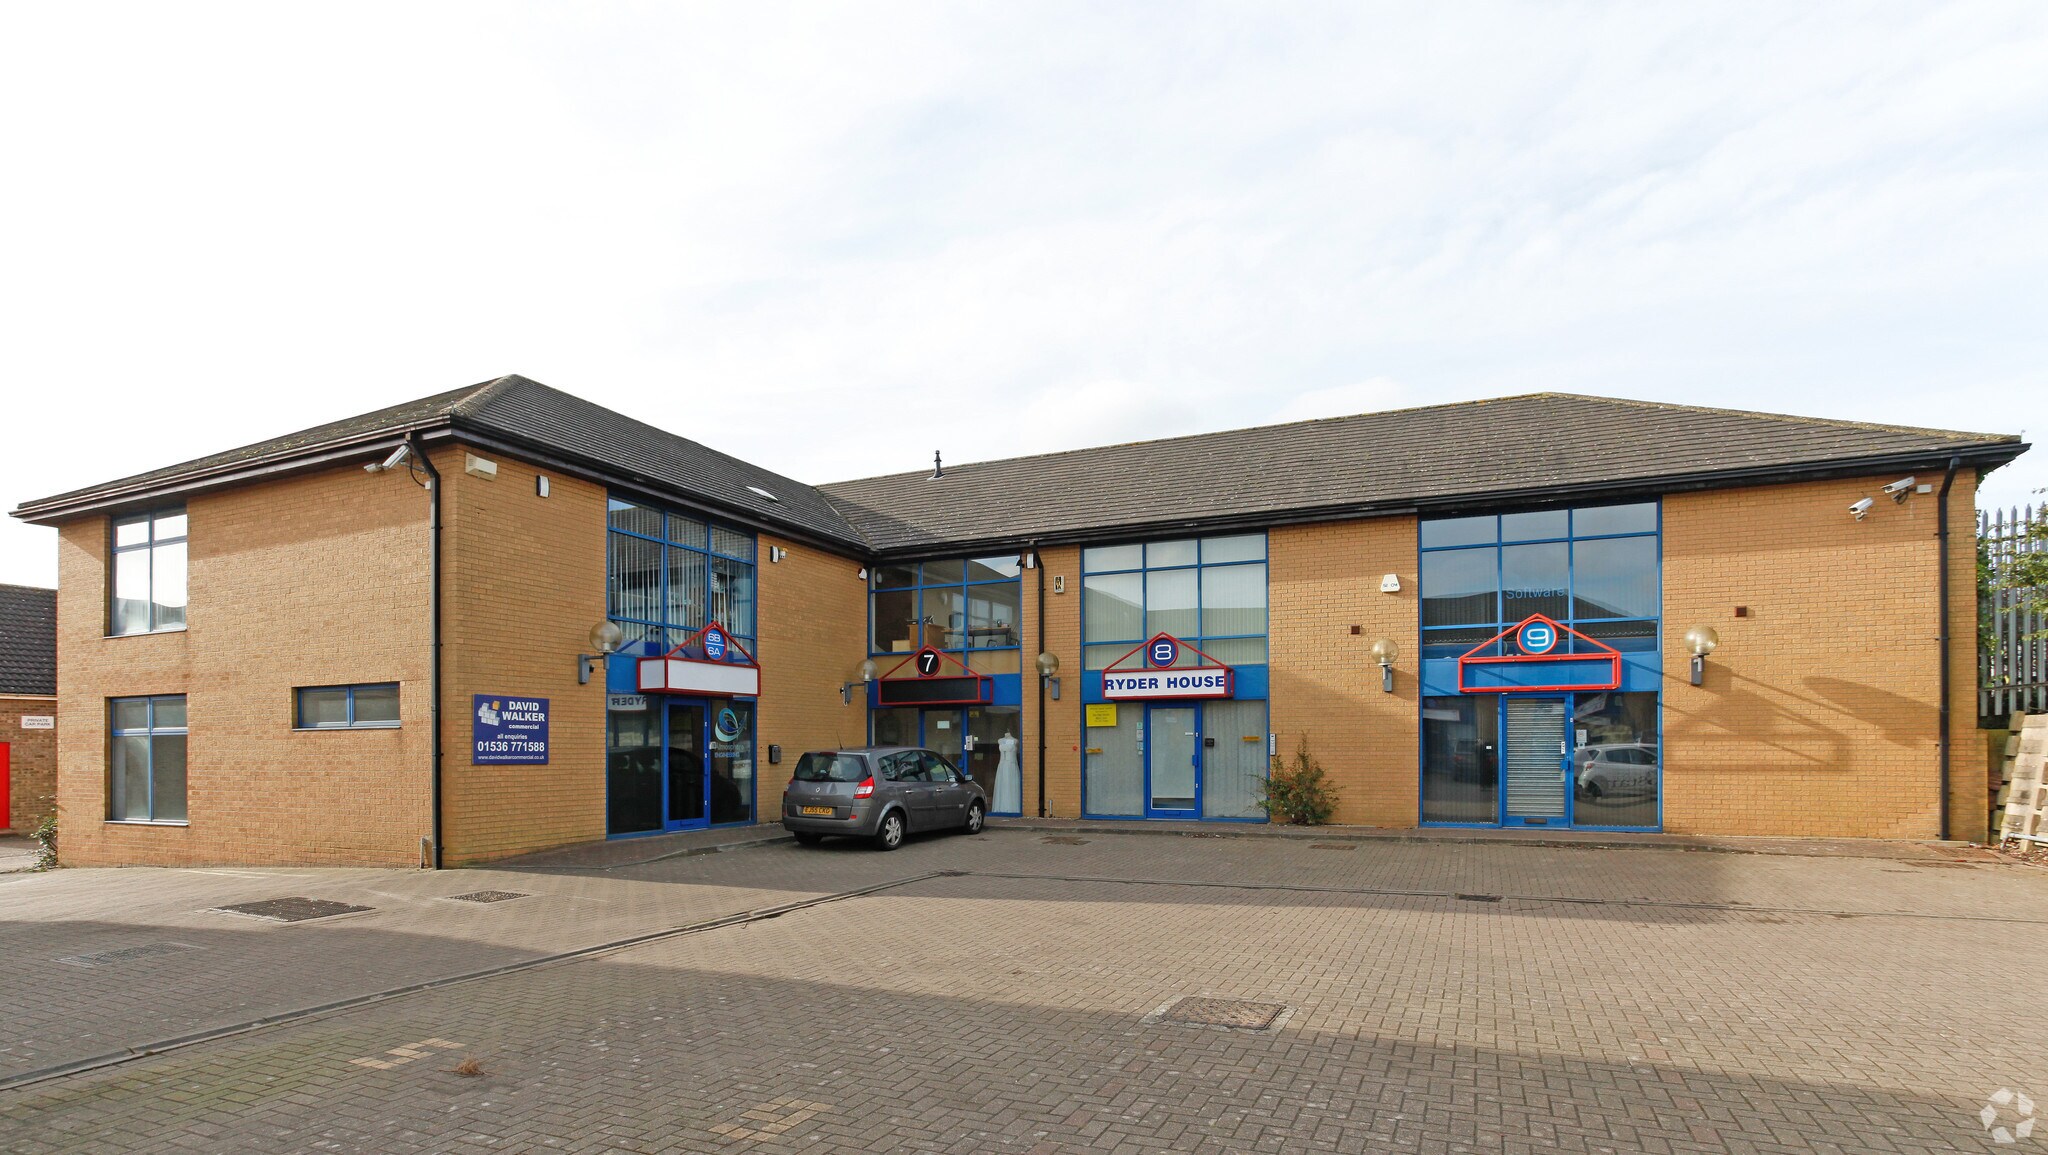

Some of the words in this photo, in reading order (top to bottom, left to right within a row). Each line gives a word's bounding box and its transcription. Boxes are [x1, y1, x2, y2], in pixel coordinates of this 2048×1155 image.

[1506, 587, 1565, 599] Software
[708, 632, 721, 642] 6B
[1527, 628, 1549, 647] 9
[707, 646, 721, 656] 6A
[1154, 644, 1172, 660] 8
[923, 654, 935, 672] 7
[1105, 677, 1159, 690] RYDER
[1166, 675, 1225, 688] HOUSE
[508, 701, 540, 711] DAVID
[502, 711, 545, 722] WALKER
[477, 741, 509, 752] 01536
[511, 741, 545, 752] 771588
